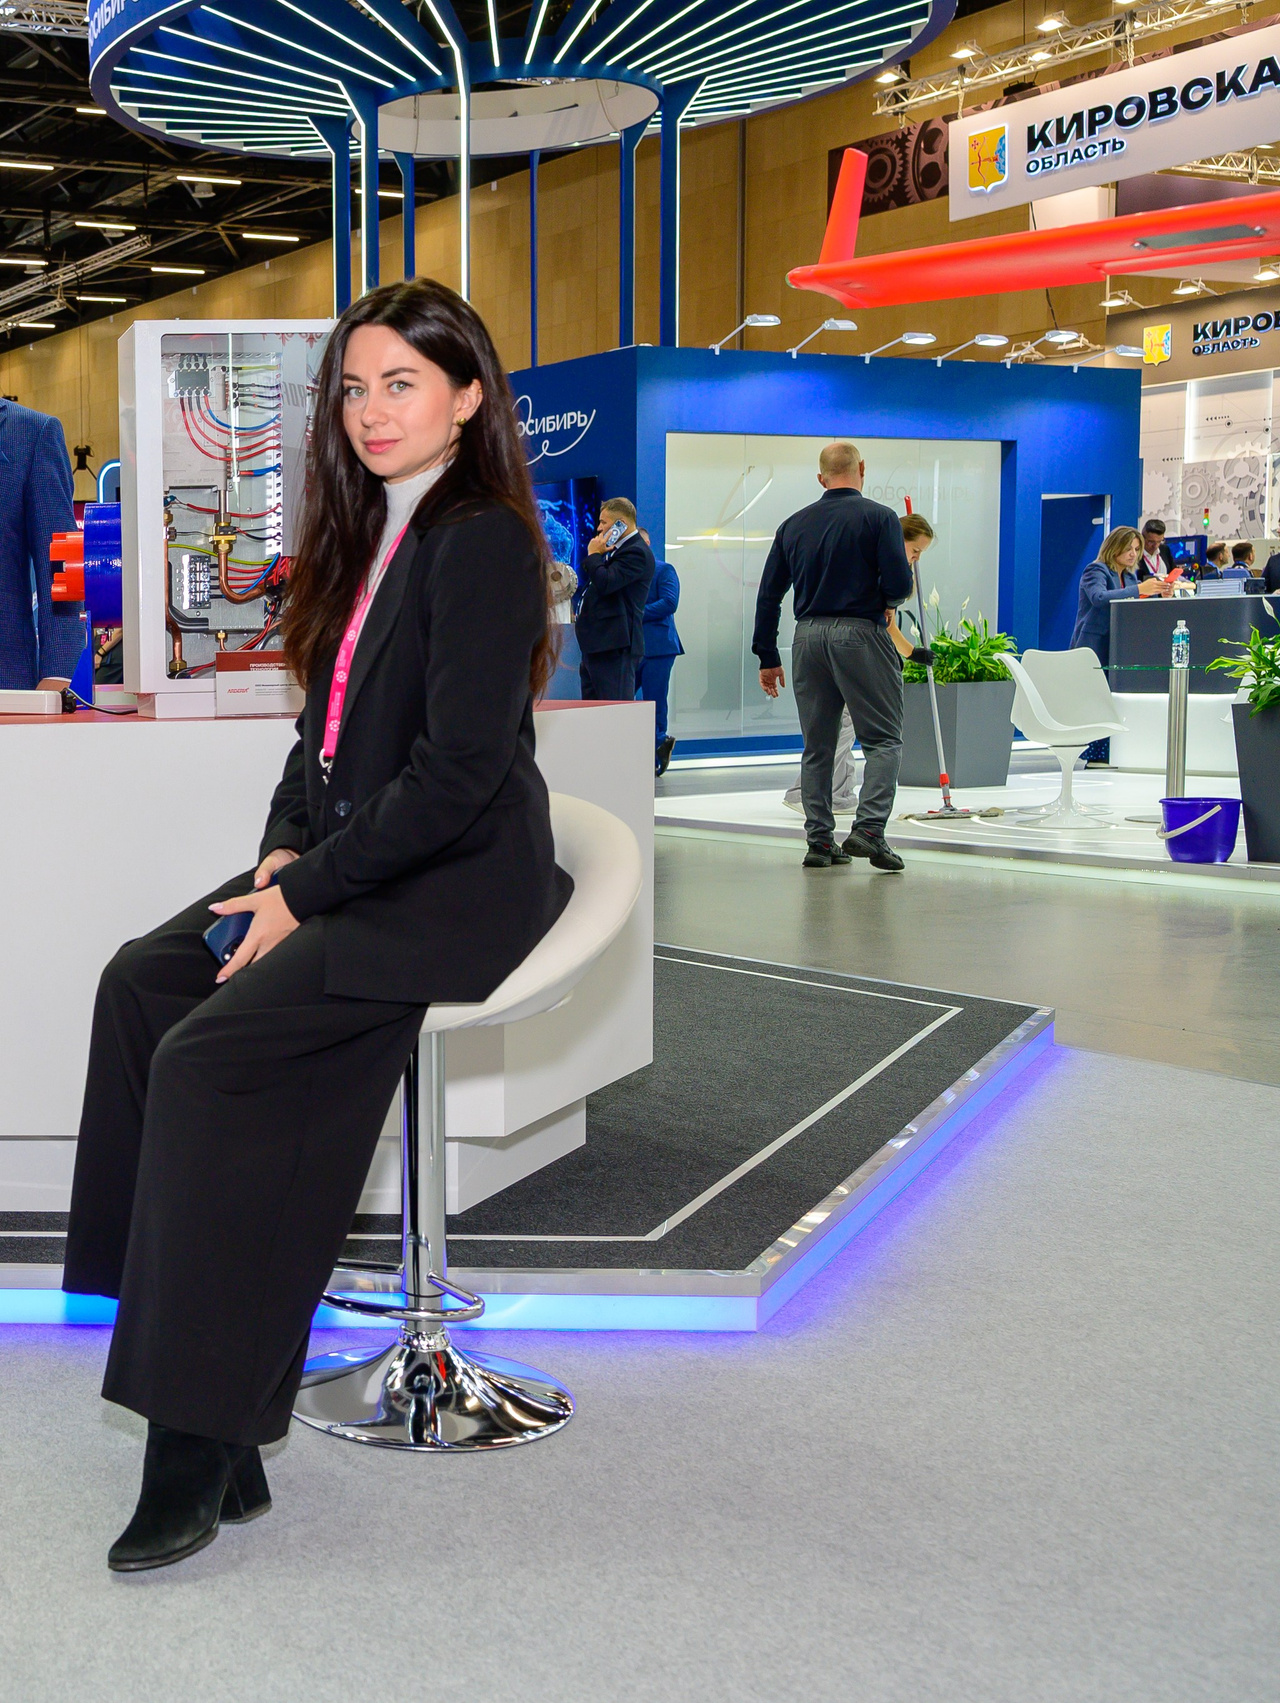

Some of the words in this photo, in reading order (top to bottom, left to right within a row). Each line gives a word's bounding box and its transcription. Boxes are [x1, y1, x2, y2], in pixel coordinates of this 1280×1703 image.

[1026, 56, 1280, 155] КИРОВСКА
[1026, 137, 1127, 176] ОБЛАСТЬ
[1192, 337, 1261, 356] ОБЛАСТЬ
